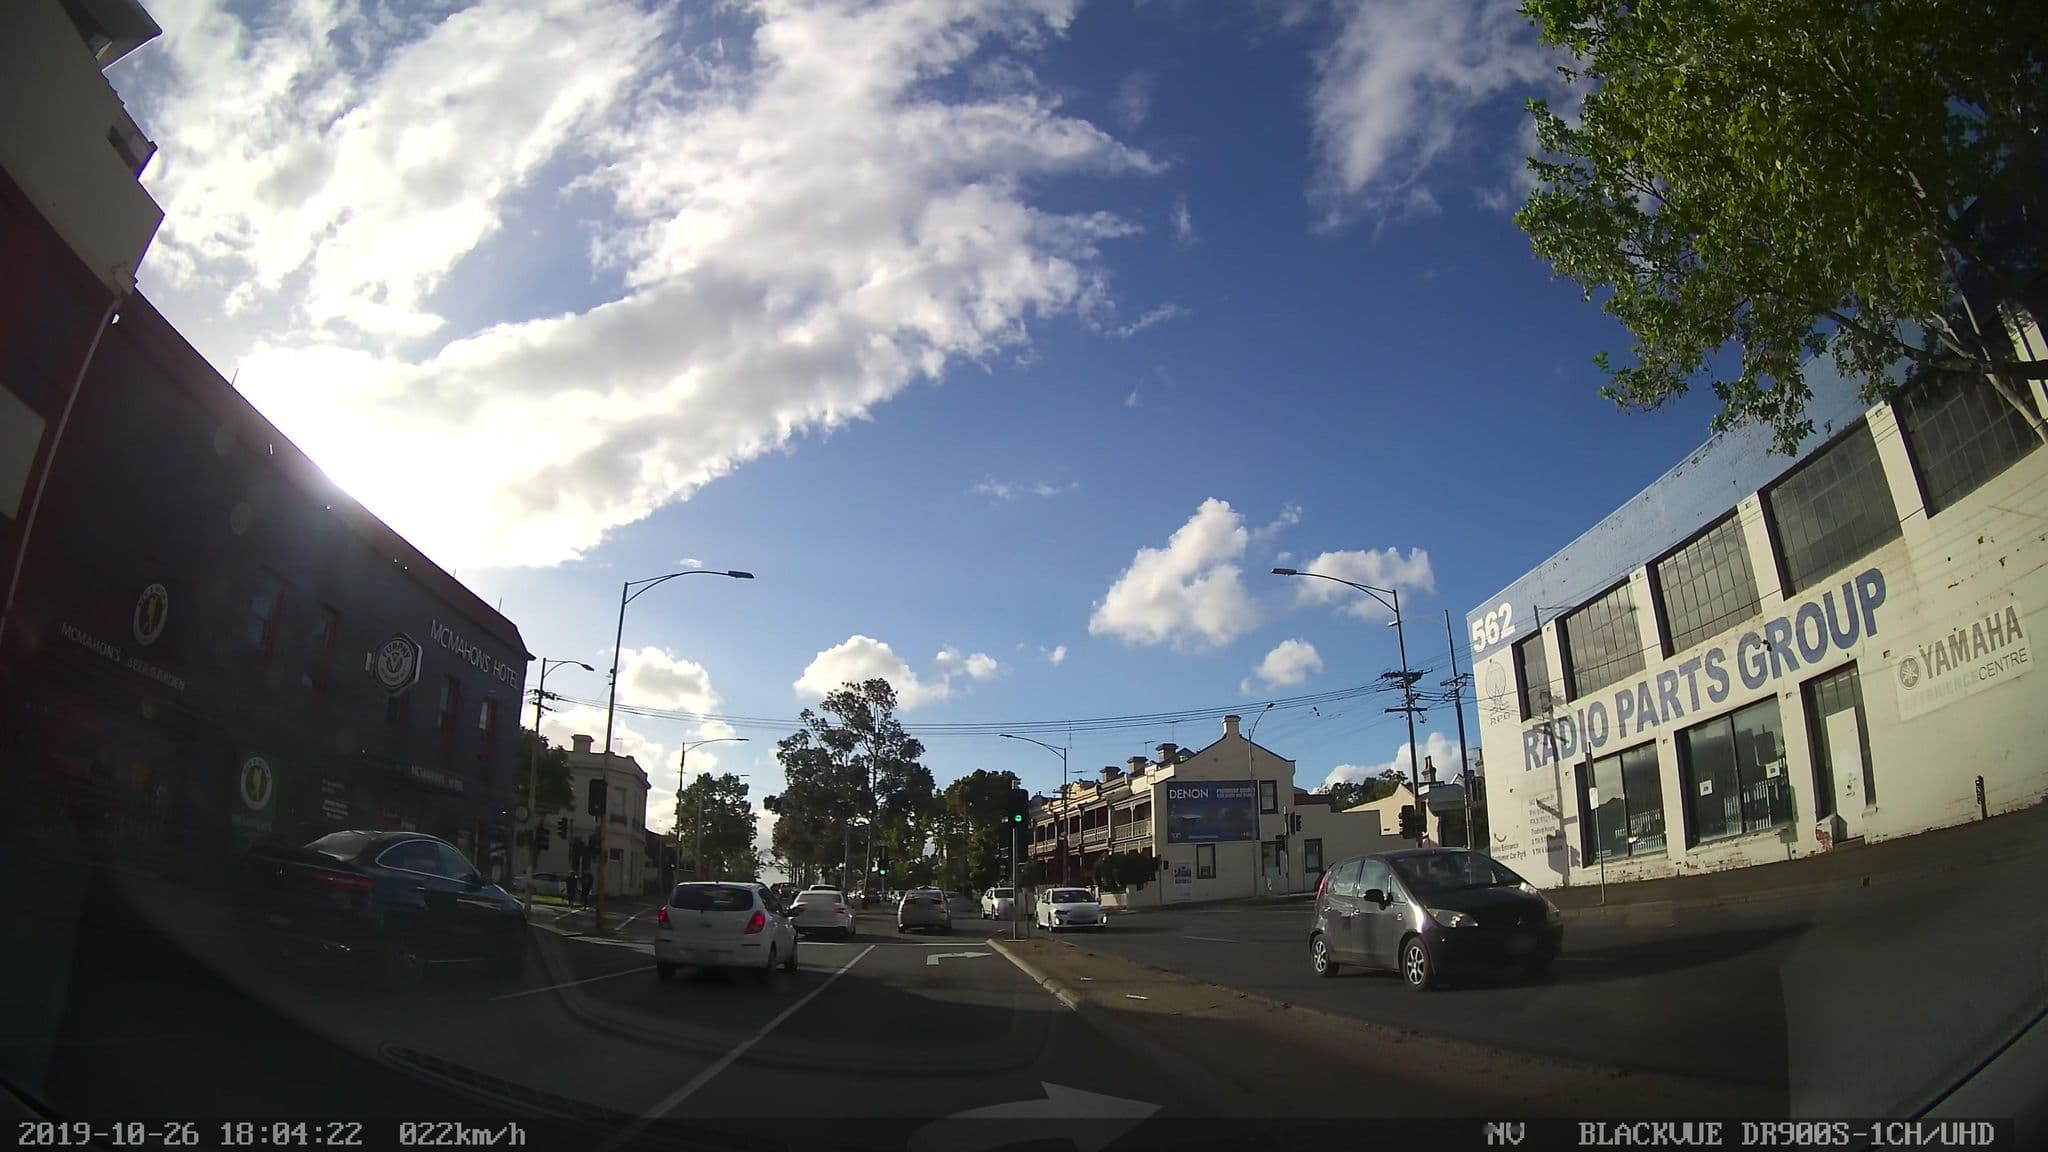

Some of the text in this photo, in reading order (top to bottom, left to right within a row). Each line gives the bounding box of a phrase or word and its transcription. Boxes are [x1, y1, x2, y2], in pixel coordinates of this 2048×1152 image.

[1471, 602, 1516, 652] 562
[1919, 605, 2023, 679] YAMAHA
[492, 658, 518, 689] HOTEL
[1522, 567, 1887, 770] RADIO PARTS GROUP
[1978, 647, 2029, 681] CENTRE
[1168, 788, 1209, 799] DENON
